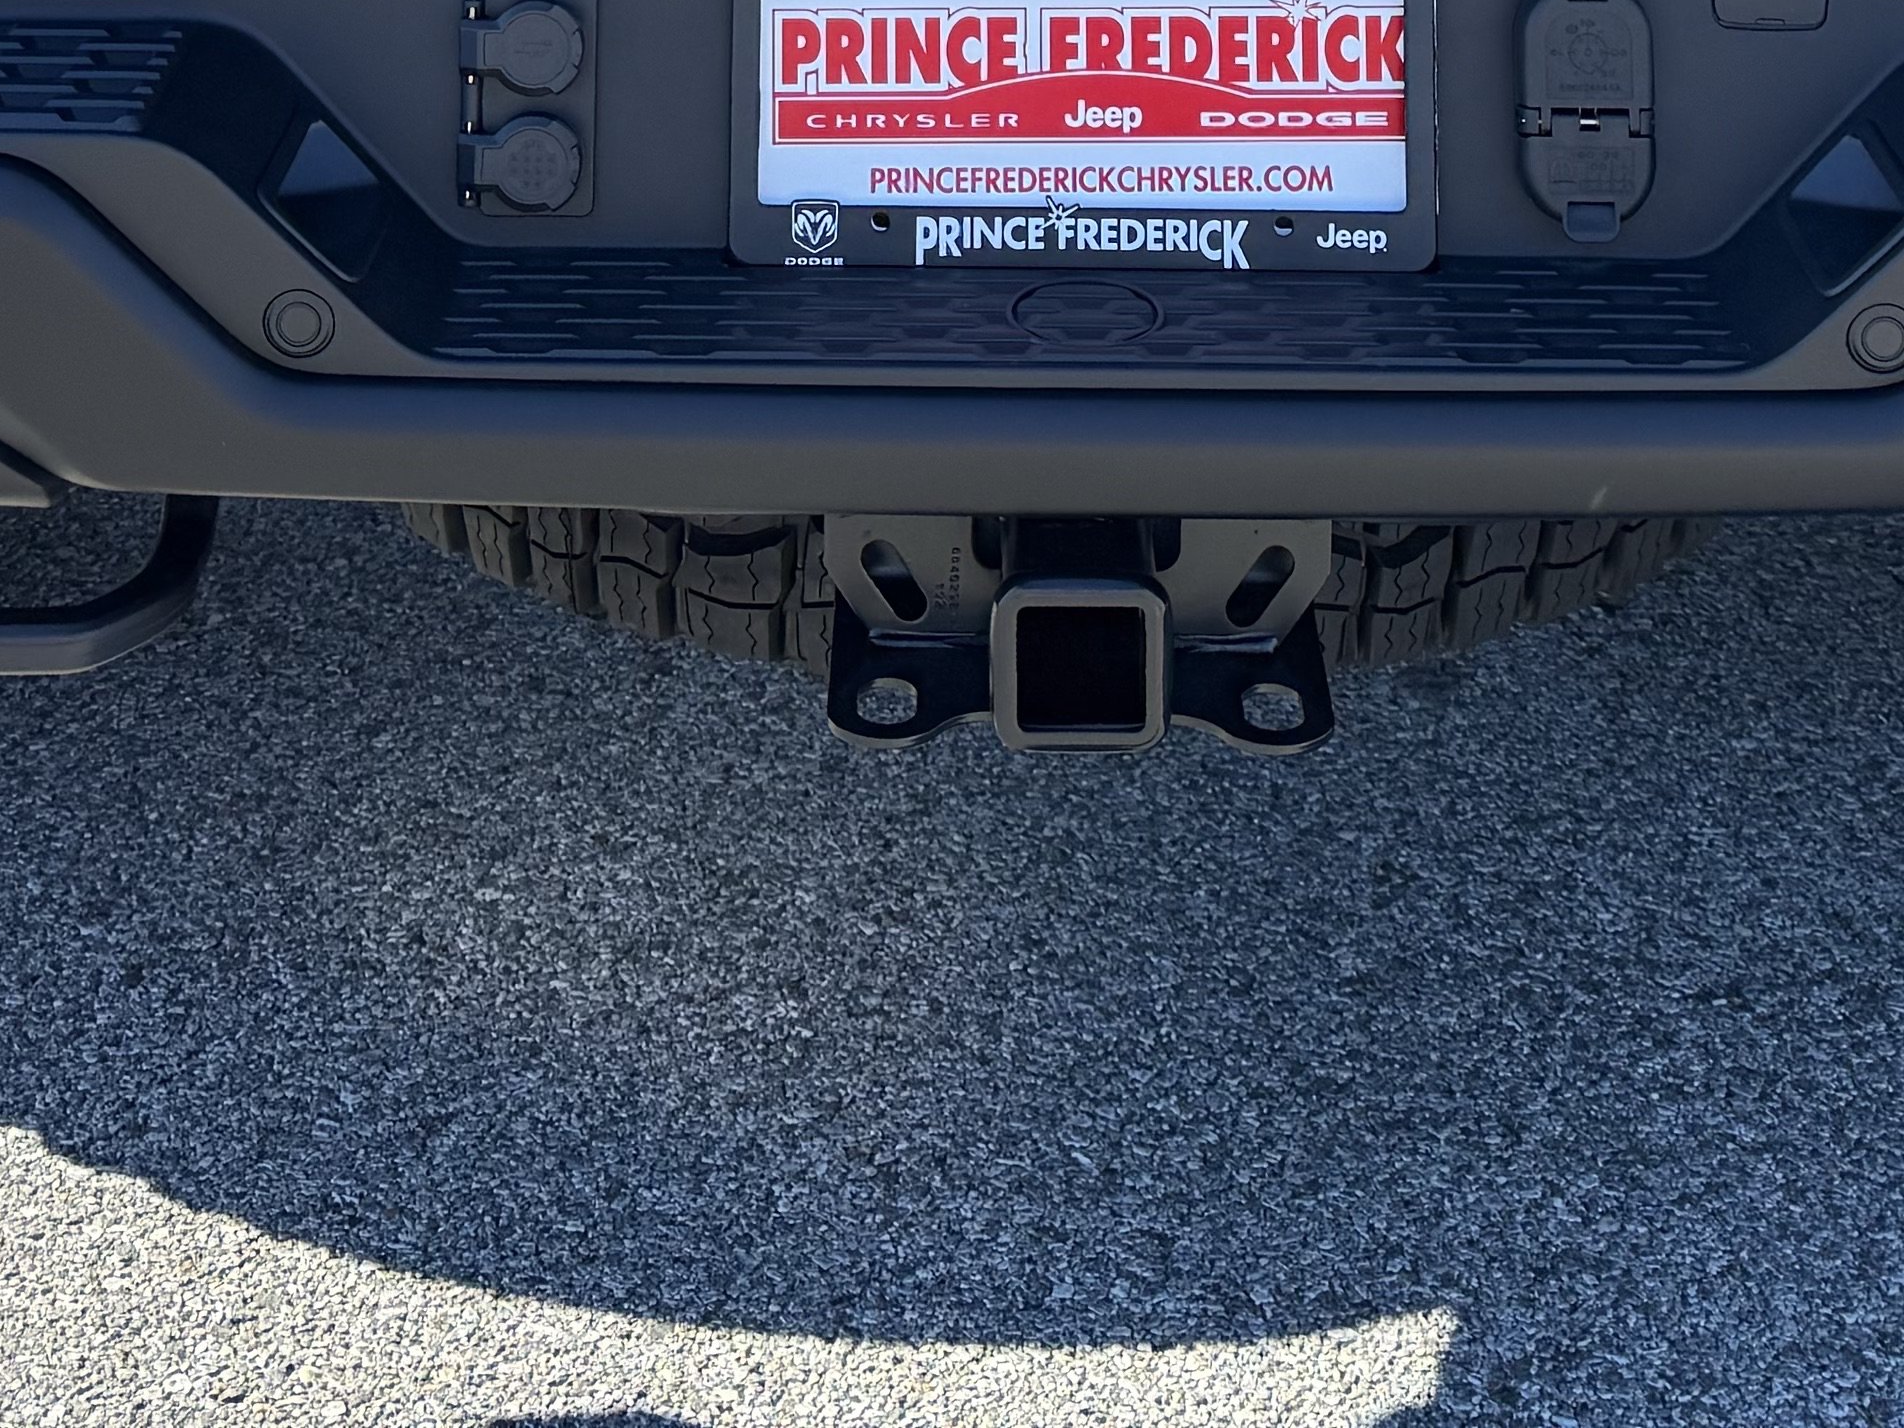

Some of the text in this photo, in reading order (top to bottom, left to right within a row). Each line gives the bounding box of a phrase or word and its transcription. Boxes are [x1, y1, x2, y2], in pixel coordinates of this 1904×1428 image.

[781, 12, 1405, 88] PRINCE FREDERICK
[806, 99, 1389, 133] CHRYSLER Jeep DODGE
[870, 165, 1334, 194] PRINCEFREDERICKCHRYSLER.COM
[915, 215, 1250, 270] PRINCE FREDERICK
[1316, 223, 1388, 254] Jeep
[784, 256, 845, 267] DODGE
